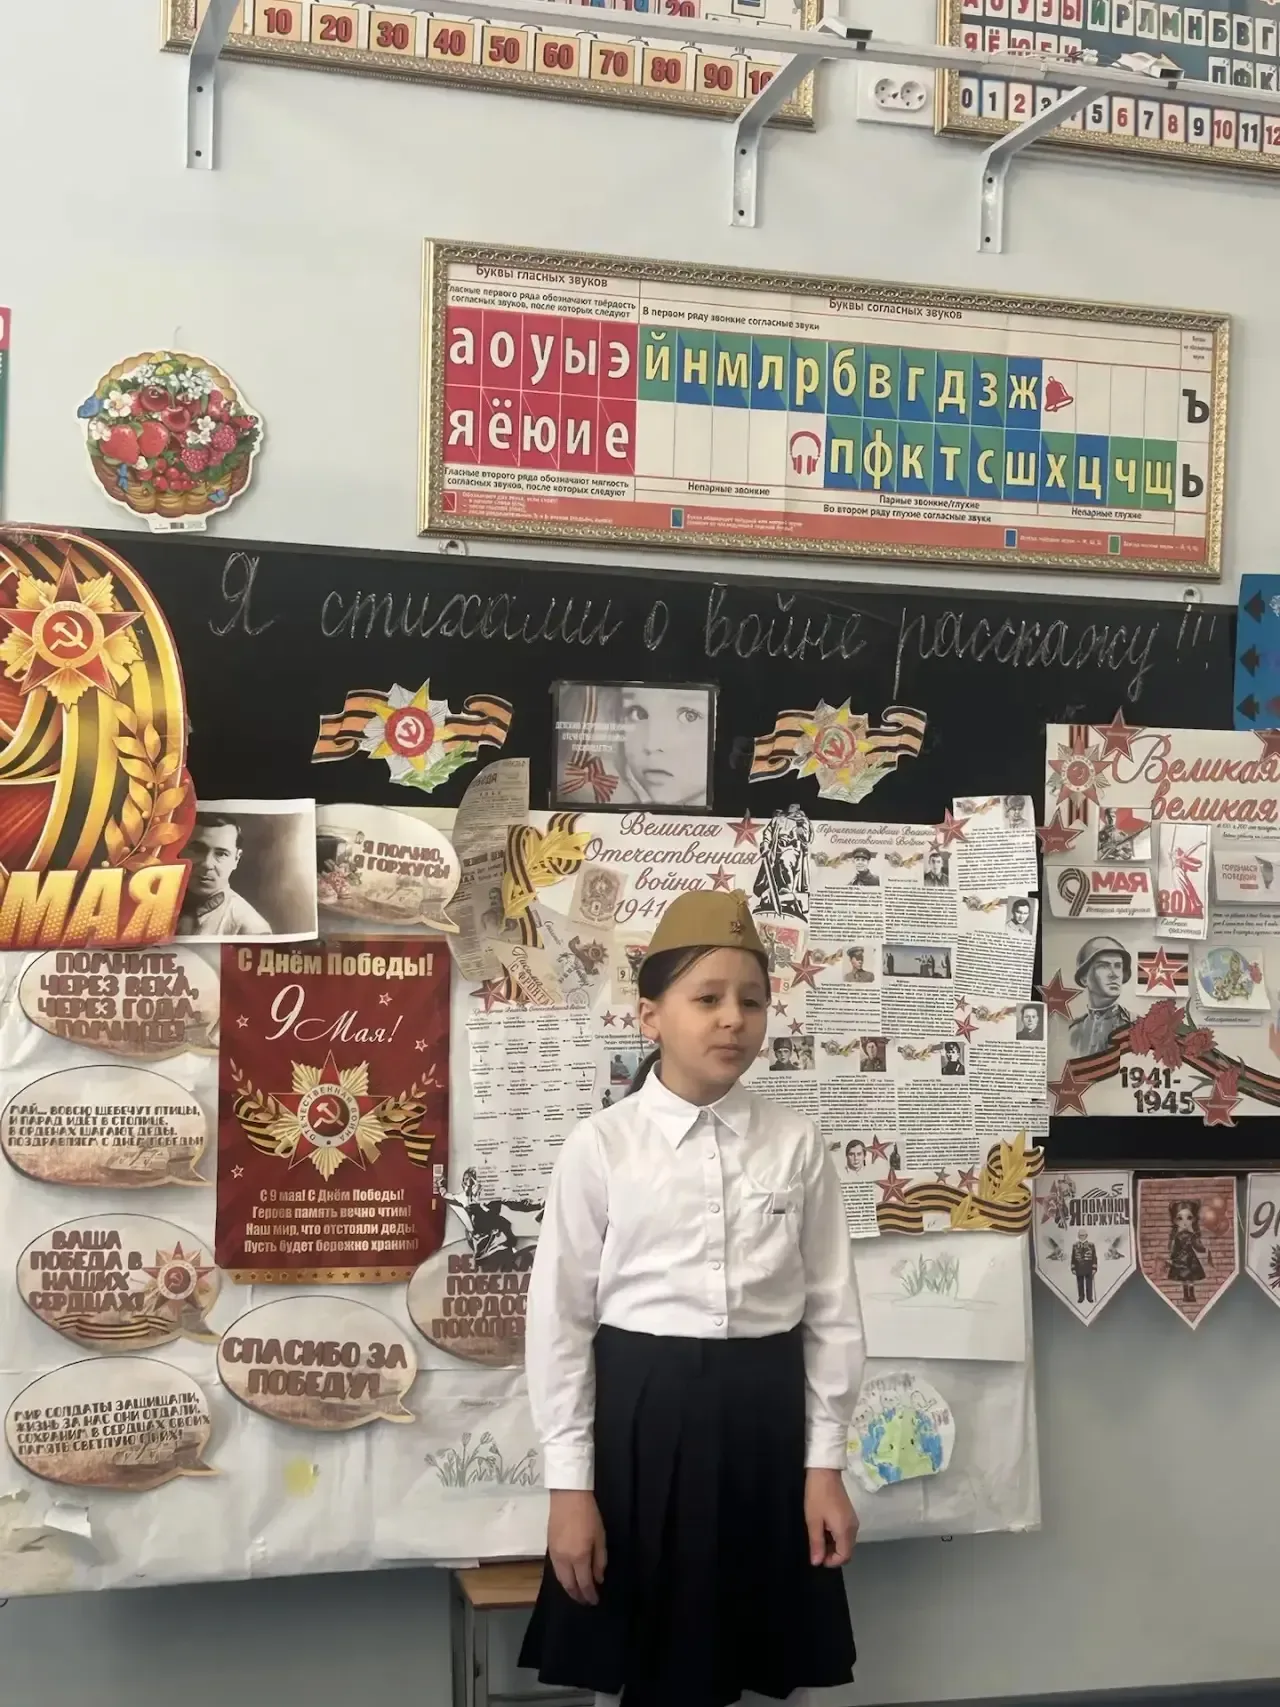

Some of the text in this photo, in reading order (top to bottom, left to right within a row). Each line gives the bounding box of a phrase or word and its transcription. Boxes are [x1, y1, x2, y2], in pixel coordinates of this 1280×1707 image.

[264, 7, 733, 91] 10 20 30 40 50 60 70 80 90
[961, 88, 1258, 143] 0 1 2 5 6 7 8 9 10 11
[476, 265, 608, 289] Буквы гласных звуков
[651, 308, 685, 320] первом
[710, 315, 746, 325] звонкие
[748, 317, 794, 329] согласные
[795, 321, 820, 331] звуки
[829, 298, 962, 320] Буквы согласных звуков
[449, 327, 1210, 423] а о у ы э й н м л р б в г д з ж ъ
[448, 398, 1204, 505] я ё ю и е п ф к т с ш х ц ч щ ь
[688, 481, 770, 496] Непарные звонкие
[879, 494, 912, 507] Парные
[823, 504, 835, 513] Во
[837, 506, 868, 515] втором
[893, 509, 921, 521] глухие
[923, 510, 966, 523] согласные
[968, 513, 992, 525] звуки
[1071, 507, 1142, 521] Непарные глухие
[209, 551, 279, 636] Я
[321, 590, 622, 645] стихами
[643, 600, 670, 651] о
[703, 581, 868, 660] войне
[893, 607, 1160, 702] расскажу
[1112, 733, 1280, 784] Великая
[620, 812, 722, 837] Великая
[353, 854, 365, 869] Я
[362, 840, 444, 865] Я ПОМНЮ,
[583, 838, 760, 866] Отечественная
[635, 867, 706, 891] война
[1092, 872, 1149, 893] МАЯ
[0, 864, 187, 948] МАЯ
[1159, 889, 1185, 913] 80
[56, 952, 184, 975] ПОМНИТЕ,
[238, 947, 434, 979] С Днём Победы!
[41, 974, 199, 1000] ЧЕРЕЗ ВЕКА,
[38, 997, 201, 1022] ЧЕРЕЗ ГОДА,
[264, 984, 403, 1044] 9 Мая!
[1119, 1066, 1181, 1089] 1941-
[50, 1106, 92, 1116] ВОВСЮ
[95, 1106, 151, 1116] ЩЕБЕЧУТ
[1134, 1090, 1195, 1115] 1945
[19, 1126, 134, 1136] ОРДЕНАХ ШАГАЮТ
[20, 1116, 63, 1126] ПАРАД
[8, 1136, 98, 1147] ПОЗДРАВЛЯЕМ
[260, 1189, 268, 1202] С
[270, 1189, 277, 1202] 9
[308, 1189, 316, 1202] С
[317, 1189, 351, 1203] Днём
[353, 1189, 405, 1203] Победы!
[252, 1205, 412, 1219] Героев память вечно чтим!
[1069, 1198, 1081, 1226] Я
[52, 1230, 121, 1250] ВАША
[246, 1223, 379, 1235] Наш что отстояли
[244, 1240, 369, 1253] Пусть будет бережно
[30, 1251, 142, 1271] ПОБЕДА В
[42, 1271, 130, 1292] НАШИХ
[29, 1291, 145, 1313] СЕРДЦАХ!
[223, 1336, 408, 1369] СПАСИБО ЗА
[247, 1369, 381, 1400] ПОБЕДУ!
[45, 1401, 112, 1419] СОЛДАТЫ
[84, 1411, 139, 1426] НАС ОНИ
[17, 1415, 210, 1444] СОХРАНИМ СЕРДЦАХ СВОИХ
[73, 1435, 136, 1451] СВЕТЛУЮ
